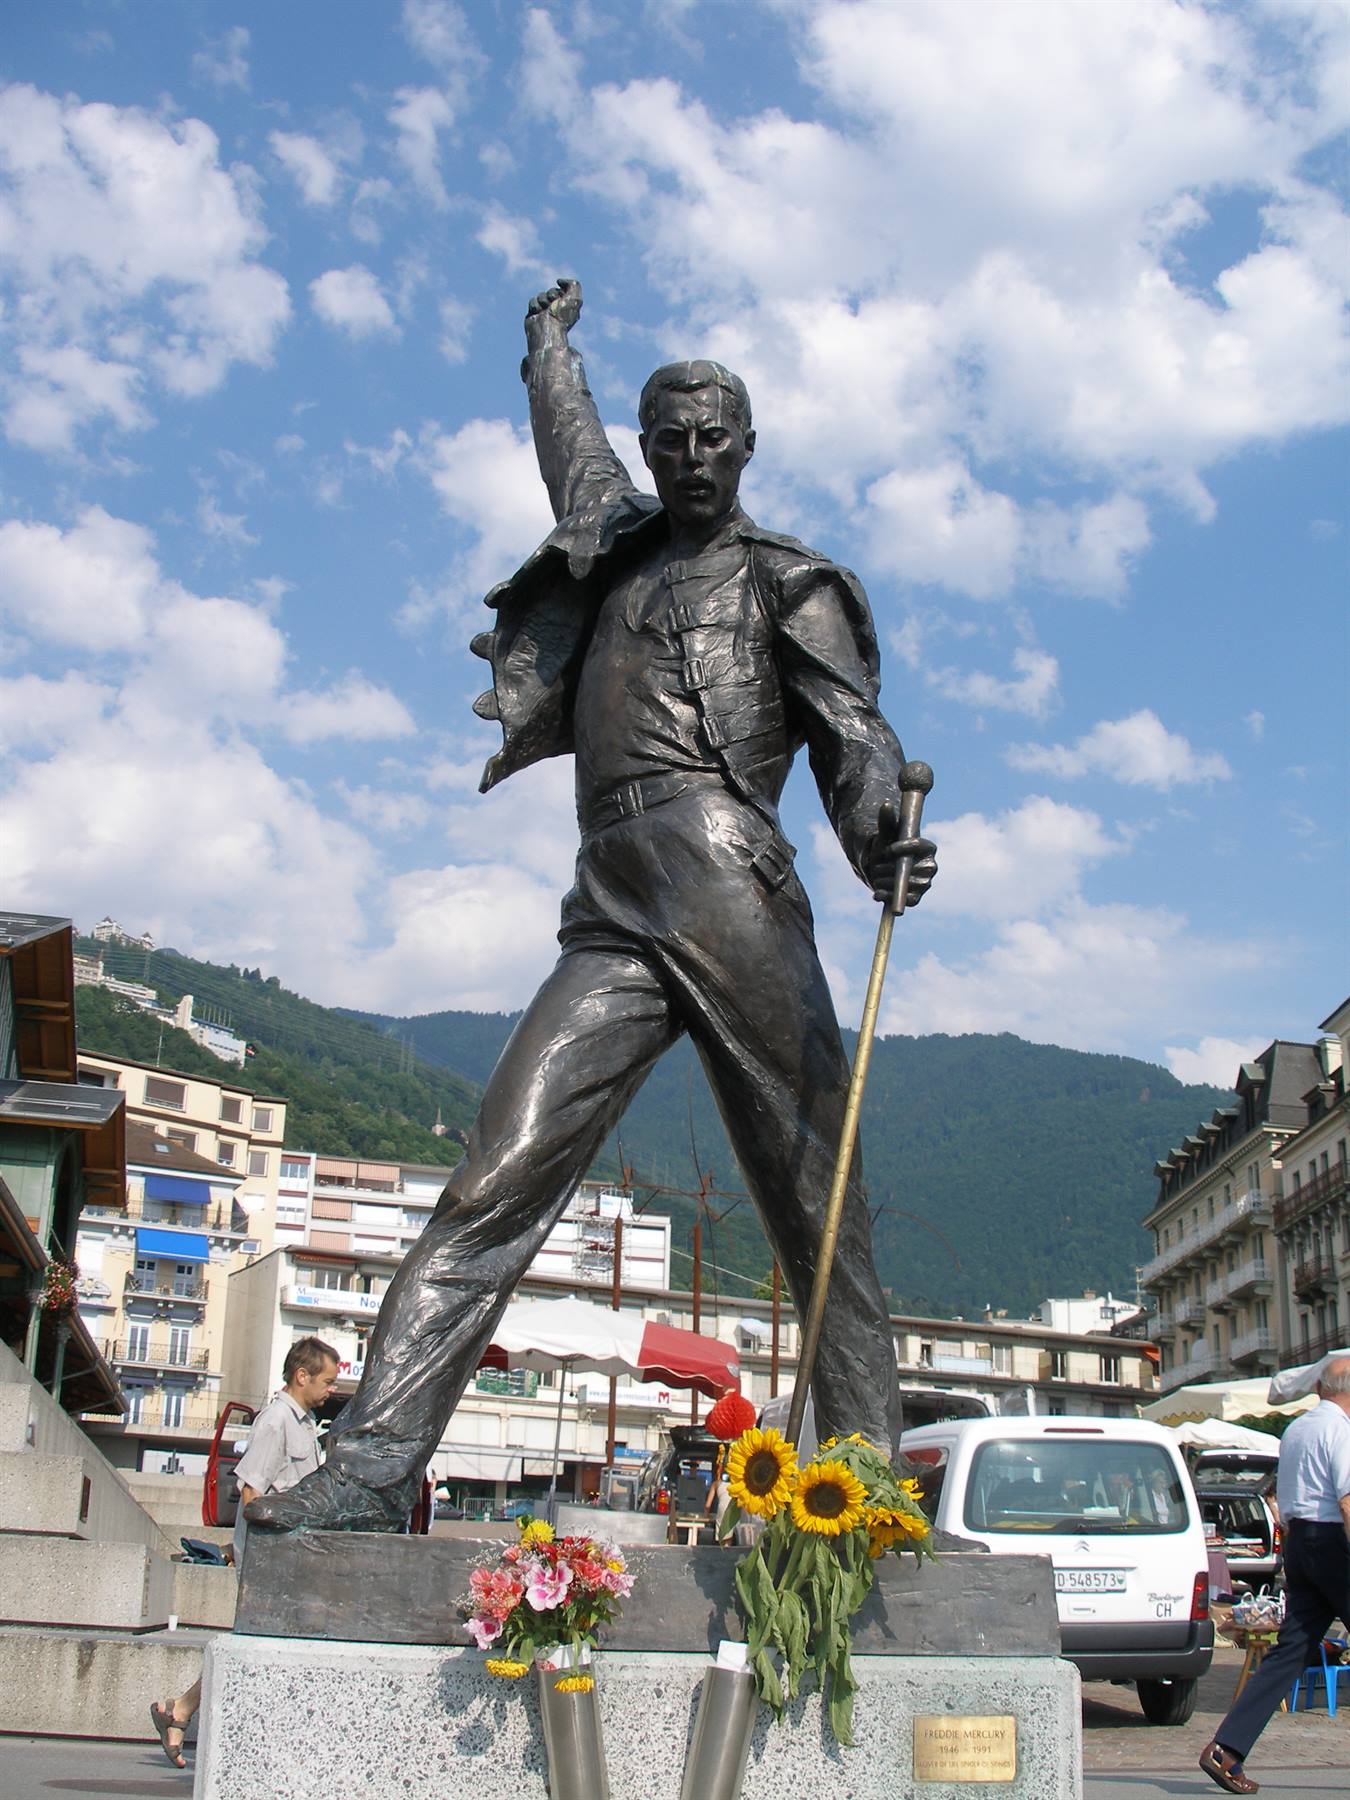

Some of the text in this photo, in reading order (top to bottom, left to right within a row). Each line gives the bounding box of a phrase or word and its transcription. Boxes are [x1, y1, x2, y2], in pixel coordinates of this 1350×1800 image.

[1156, 1602, 1172, 1618] CH
[924, 1729, 1006, 1740] FREDDIE MERCURY
[940, 1745, 959, 1754] 1946
[973, 1745, 991, 1754] 1991
